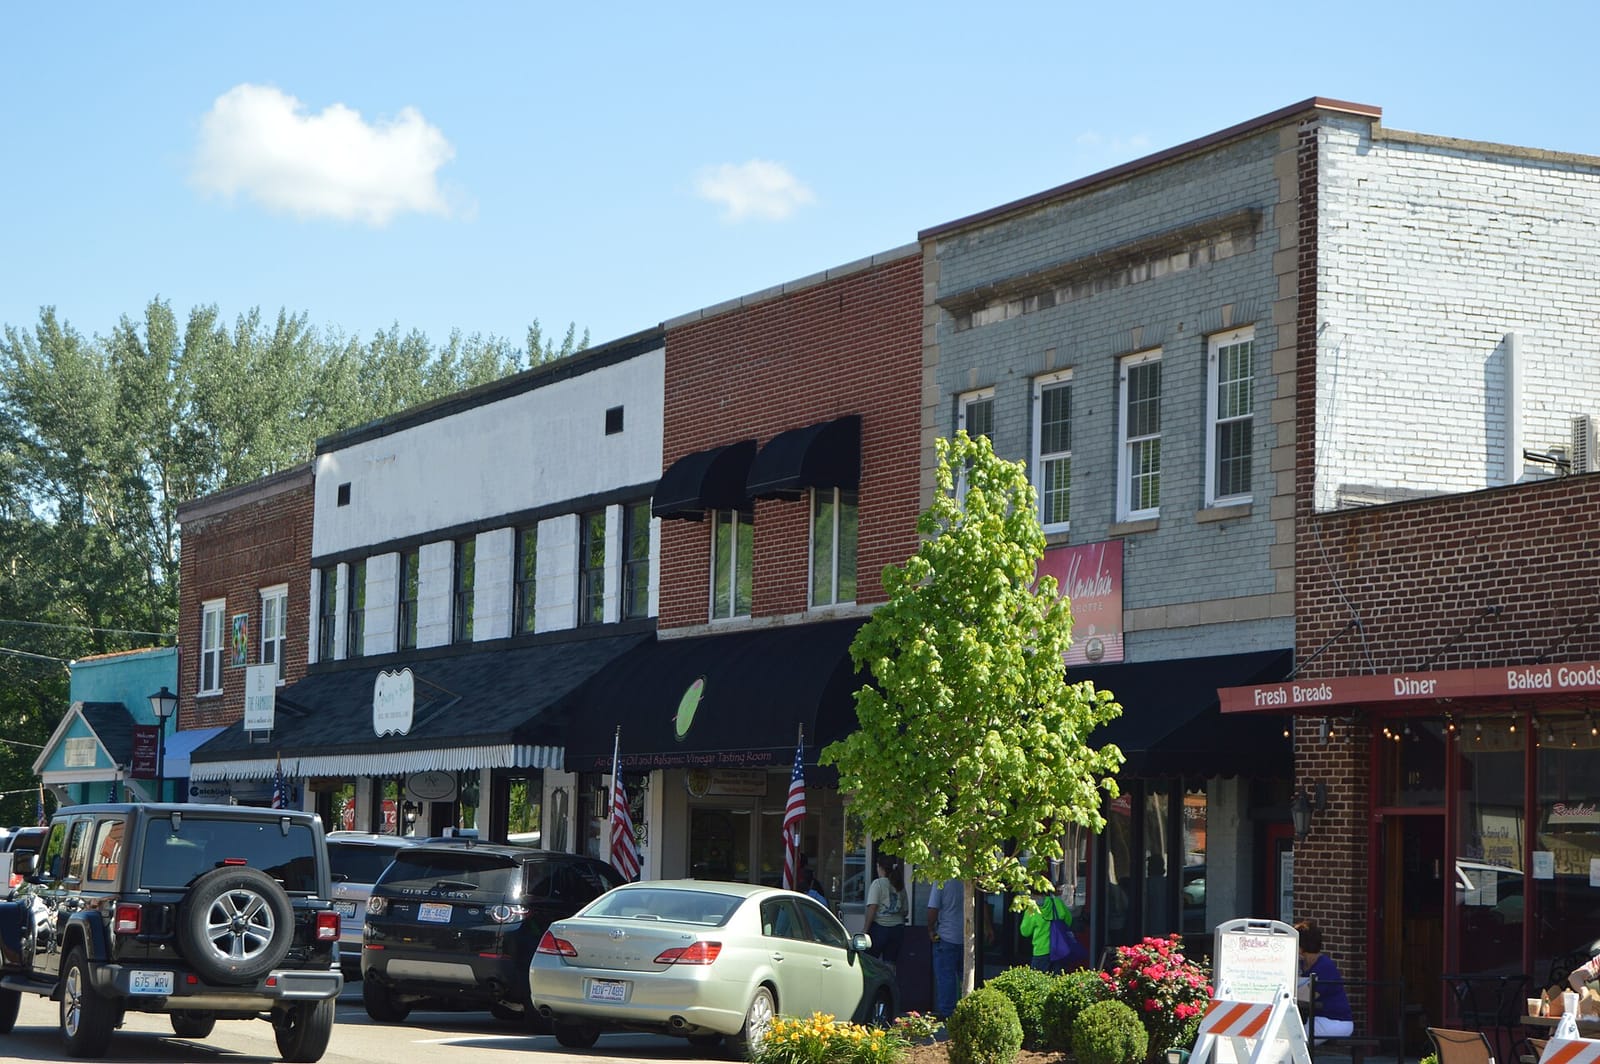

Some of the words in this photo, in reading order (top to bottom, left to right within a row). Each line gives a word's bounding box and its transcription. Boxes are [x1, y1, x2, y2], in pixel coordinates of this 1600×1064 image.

[1056, 543, 1113, 600] Mountain
[1394, 677, 1437, 696] Diner
[1507, 669, 1552, 689] Baked
[1254, 687, 1287, 706] Fresh
[1292, 683, 1333, 702] Breads
[594, 757, 606, 767] An
[626, 755, 639, 766] Oil
[639, 755, 653, 766] and
[653, 753, 685, 766] Balsamic
[686, 753, 716, 766] Vinegar
[718, 752, 745, 765] Tasting
[746, 751, 772, 761] Room
[402, 888, 473, 898] DISCOVERY
[134, 976, 150, 988] 675
[154, 977, 169, 988] WRV
